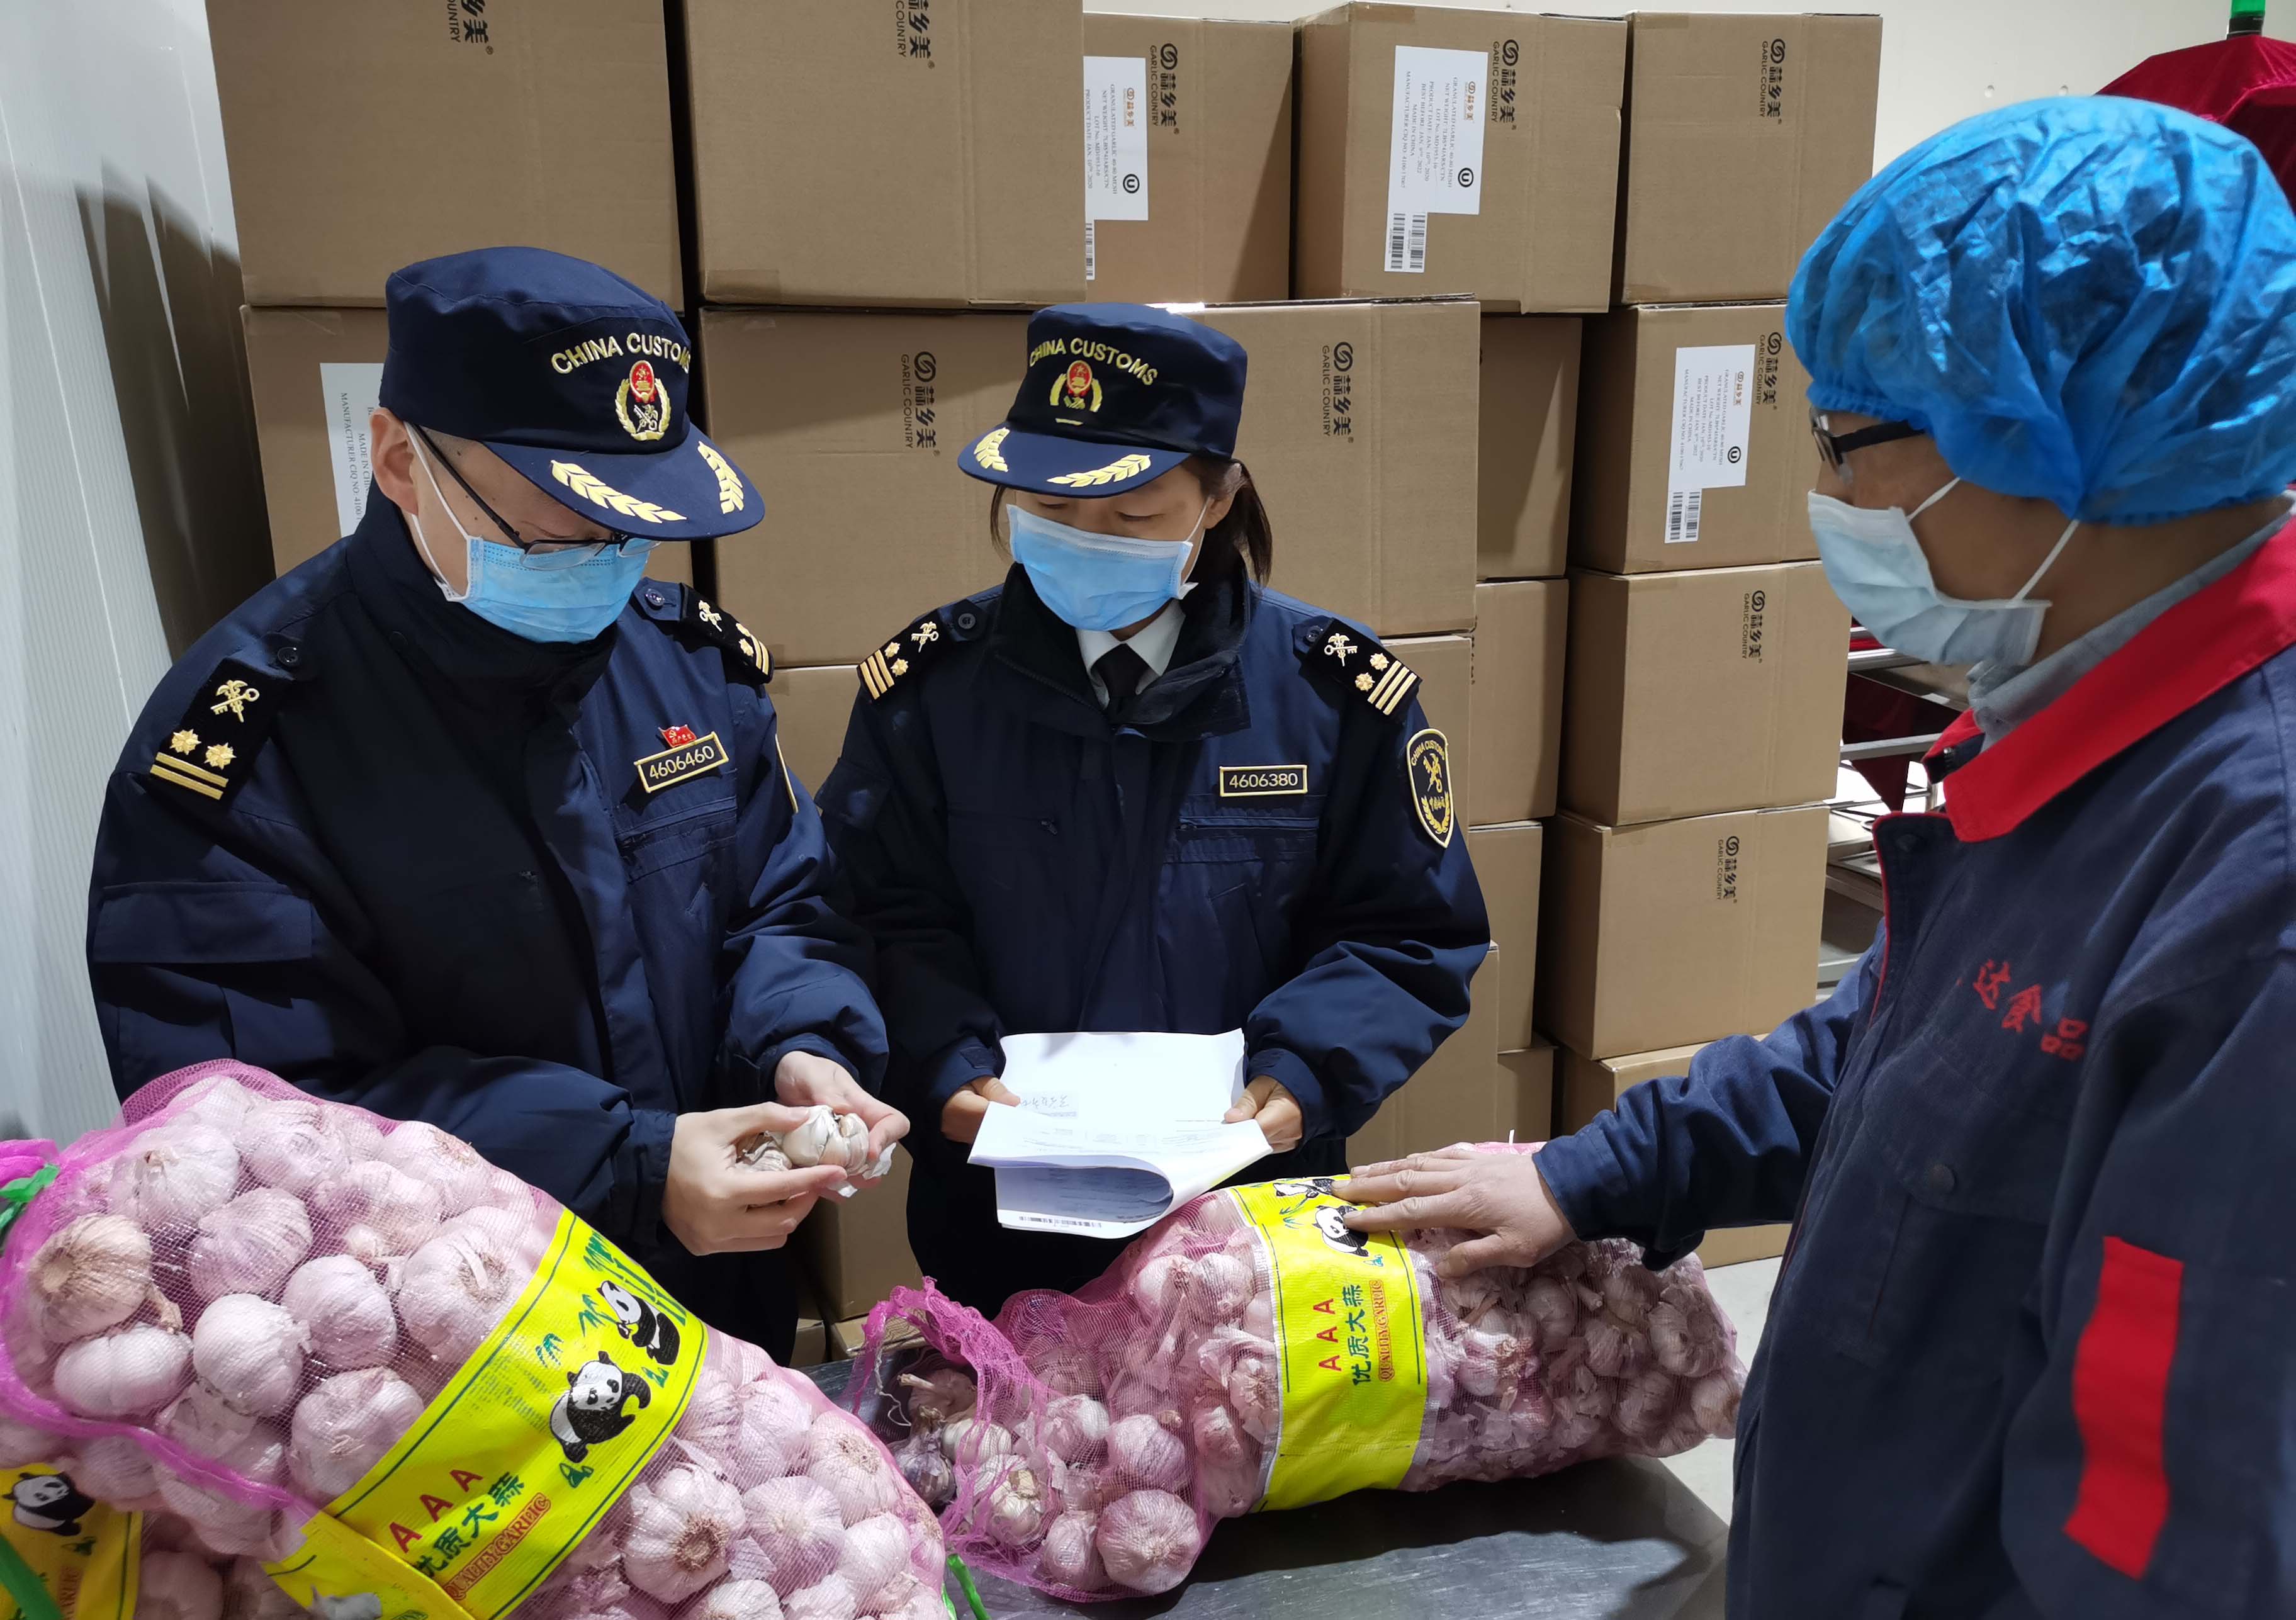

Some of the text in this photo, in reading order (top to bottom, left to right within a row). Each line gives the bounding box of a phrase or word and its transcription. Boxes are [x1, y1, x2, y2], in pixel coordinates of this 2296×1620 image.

[896, 0, 906, 57] COUNTRY
[1491, 79, 1499, 122] COUNTRY
[551, 332, 691, 374] CHINA CUSTOMS
[1029, 337, 1158, 386] CHINA CUSTOMS
[1322, 346, 1331, 385] GARLIC
[901, 354, 913, 448] GARLIC COUNTRY
[1755, 368, 1764, 405] COUNTRY
[340, 393, 356, 463] MANUFACTURER
[349, 464, 358, 479] CIQ
[359, 433, 368, 458] MADE
[361, 460, 369, 470] IN
[649, 745, 714, 780] 4606460
[1229, 773, 1298, 788] 4606380
[1342, 1285, 1371, 1386] 优质大蒜
[494, 1494, 549, 1553] GARLIC
